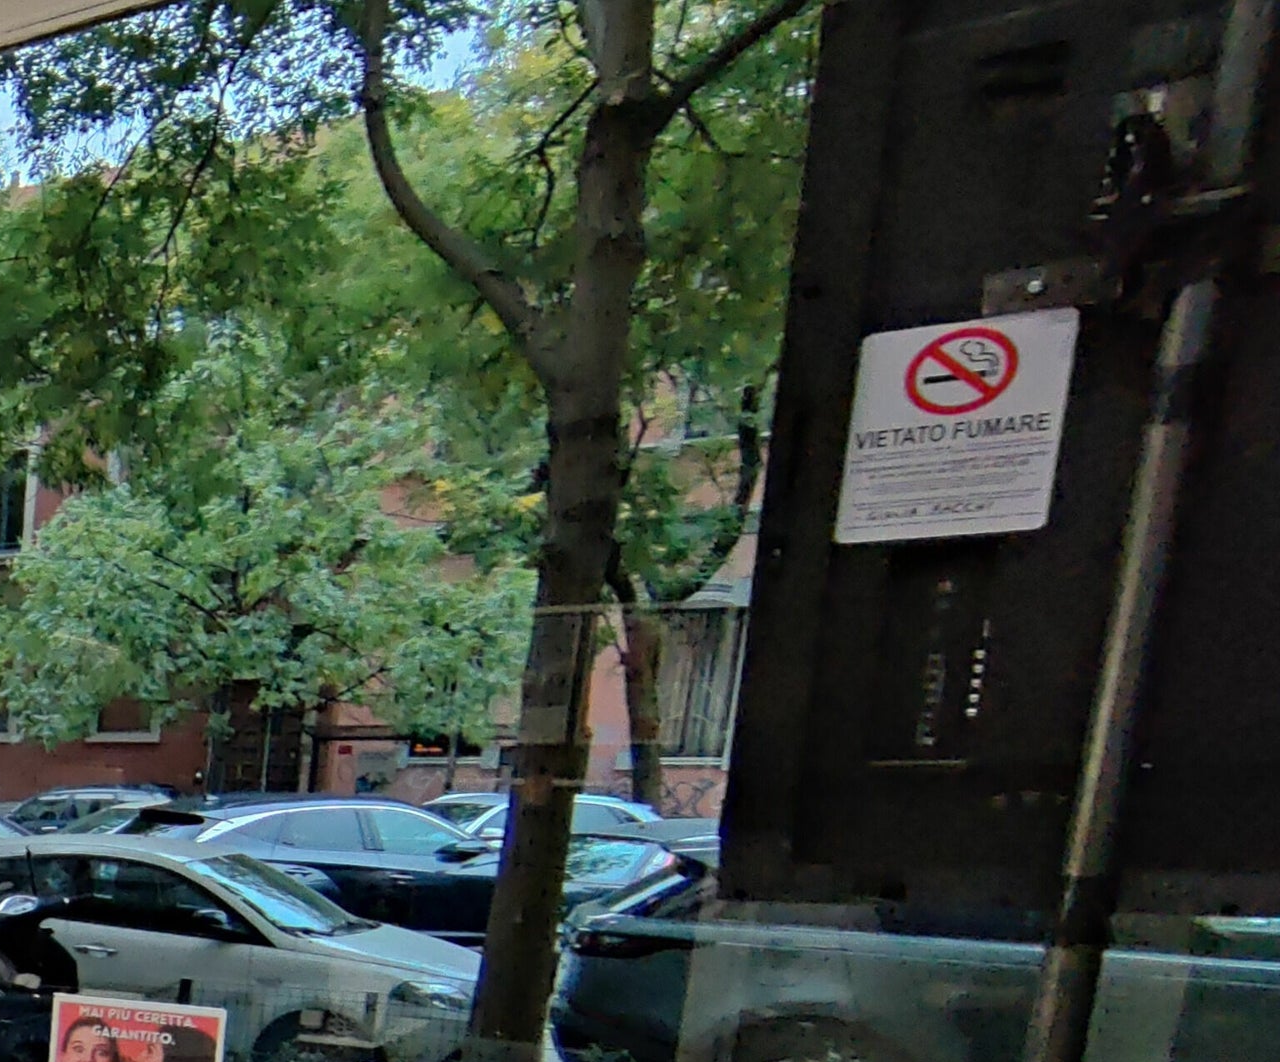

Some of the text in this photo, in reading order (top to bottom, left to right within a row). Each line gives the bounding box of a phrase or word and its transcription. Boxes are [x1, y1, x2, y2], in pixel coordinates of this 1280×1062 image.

[855, 412, 1052, 449] VIETATO FUMARE
[79, 1005, 105, 1019] MAI
[92, 1024, 177, 1046] GARANTITO.
